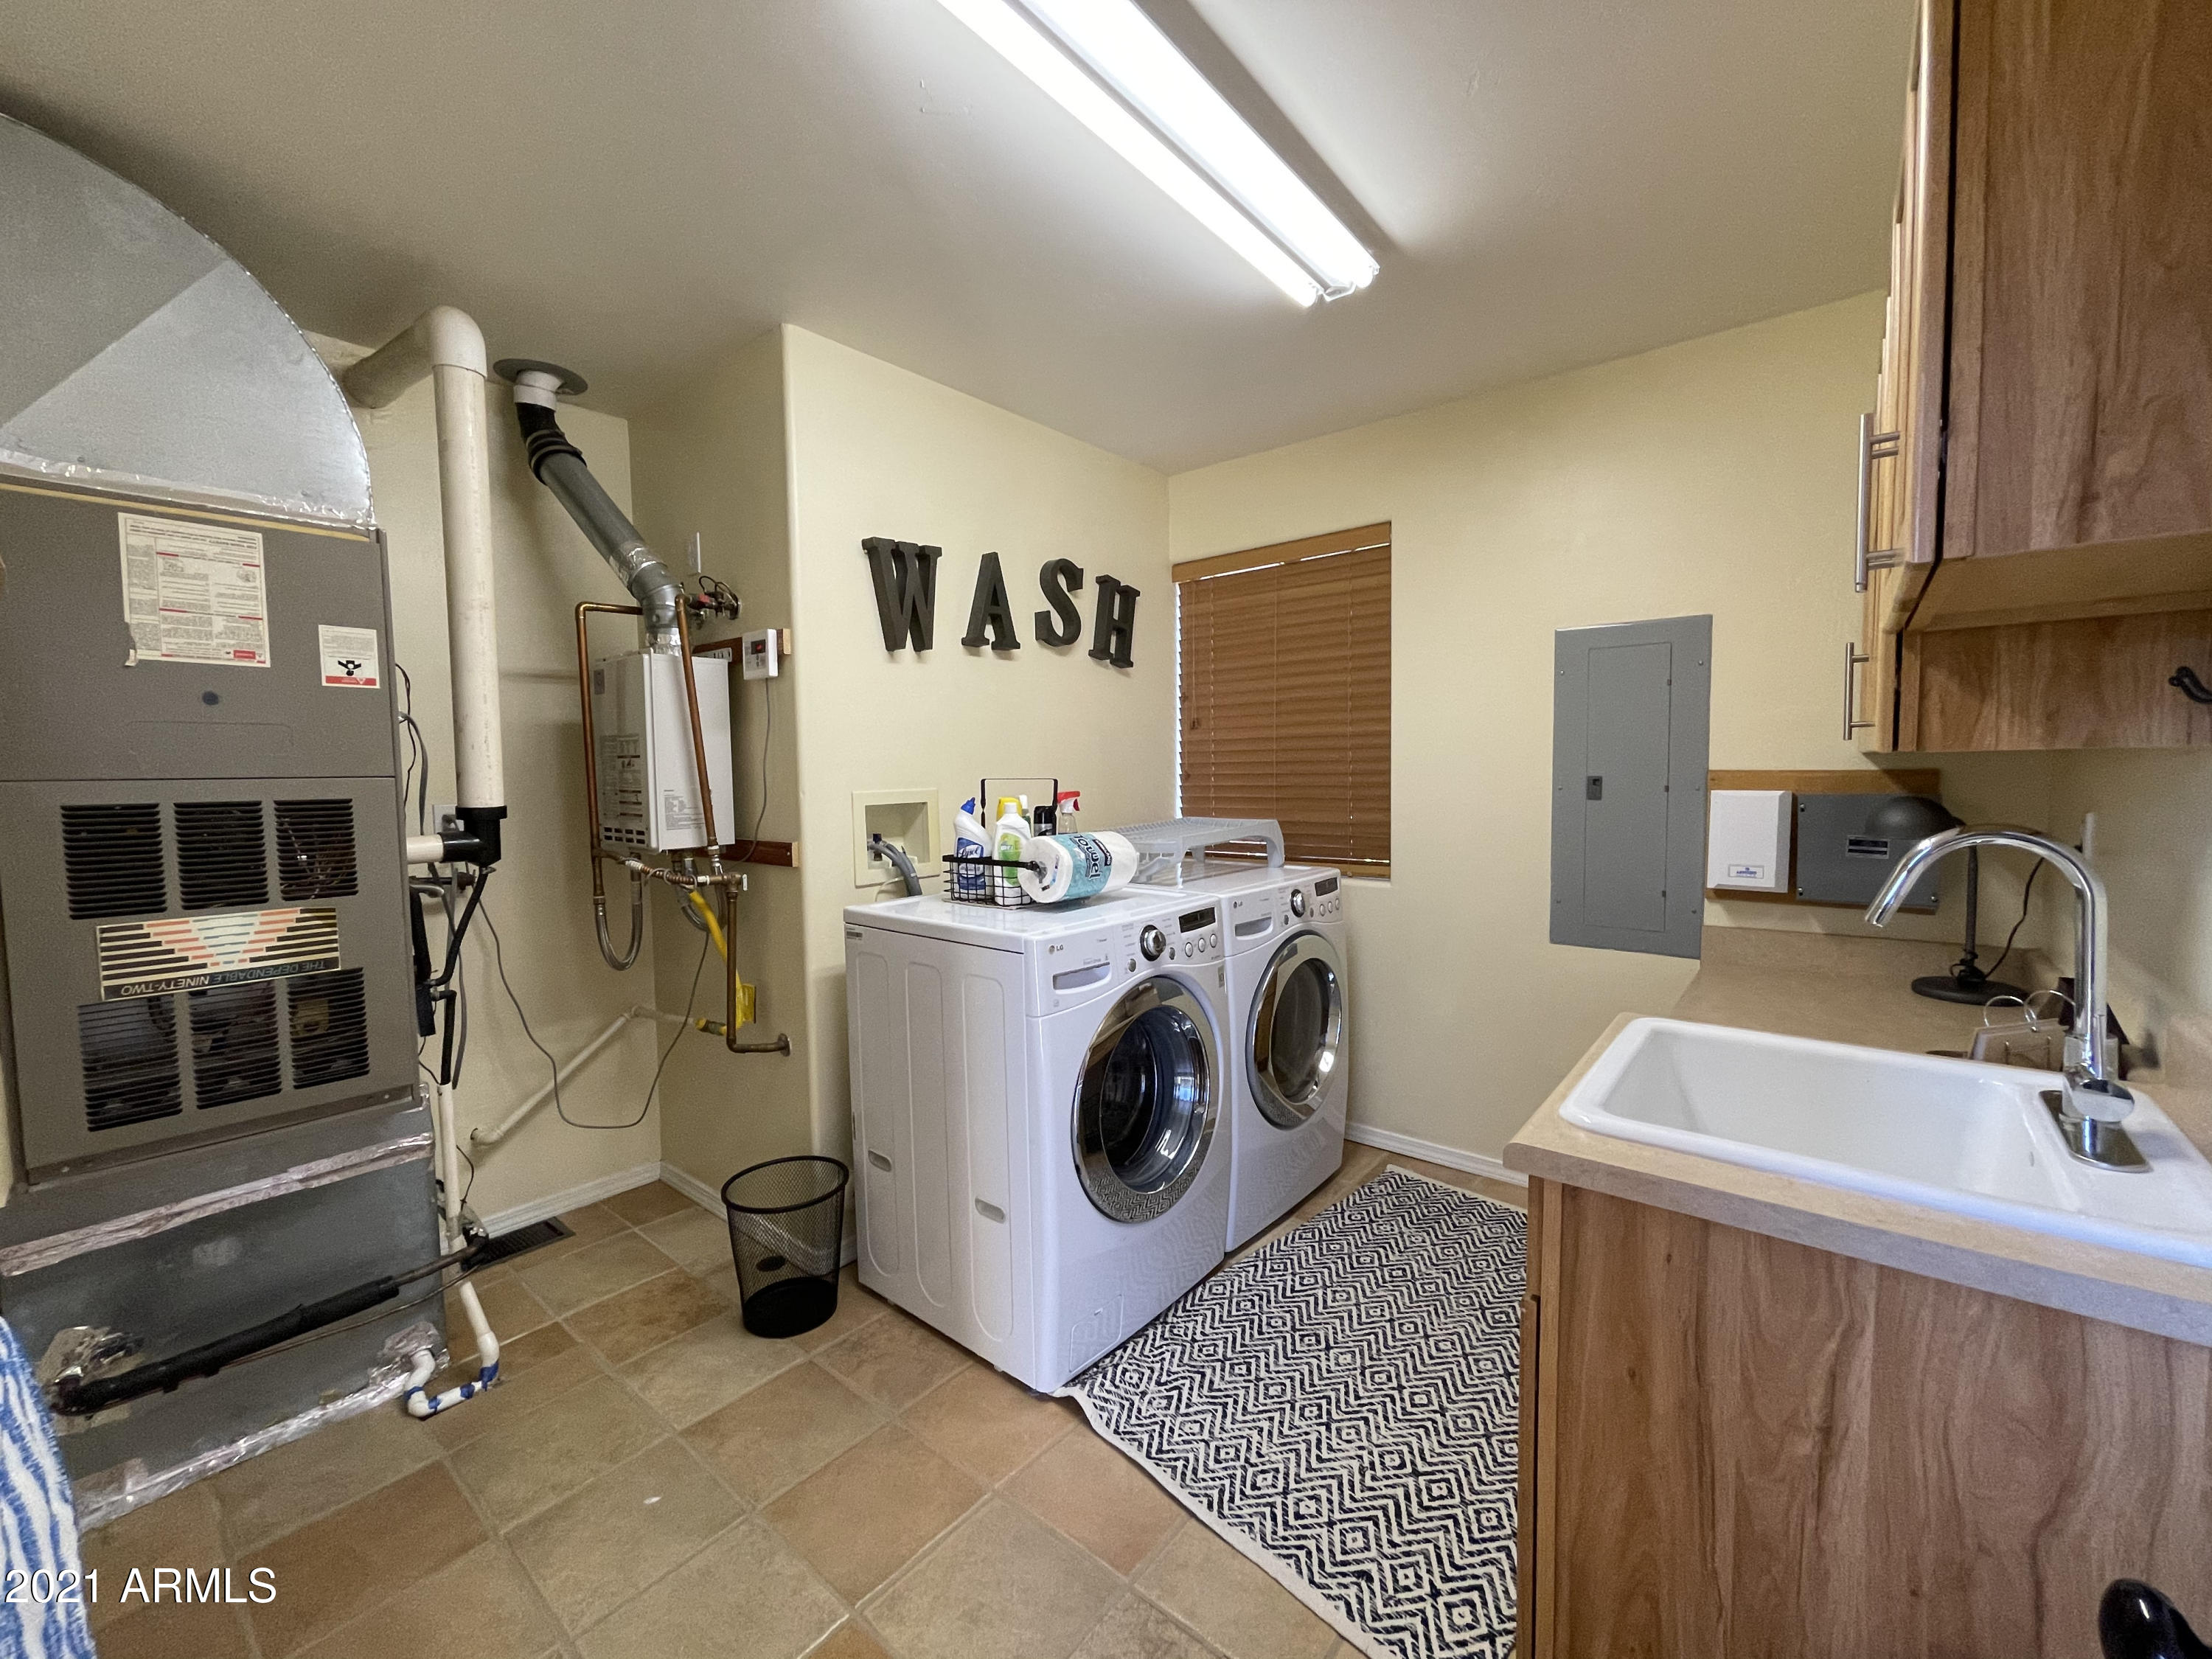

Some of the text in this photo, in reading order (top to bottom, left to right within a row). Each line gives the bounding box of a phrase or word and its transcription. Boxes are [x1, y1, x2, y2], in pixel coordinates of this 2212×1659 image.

[861, 537, 1141, 668] WASH
[1073, 834, 1102, 880] Towel
[1096, 840, 1111, 865] LAND
[1056, 944, 1064, 952] LG
[121, 960, 327, 996] THE DEPENDABLE NINETY-TWO
